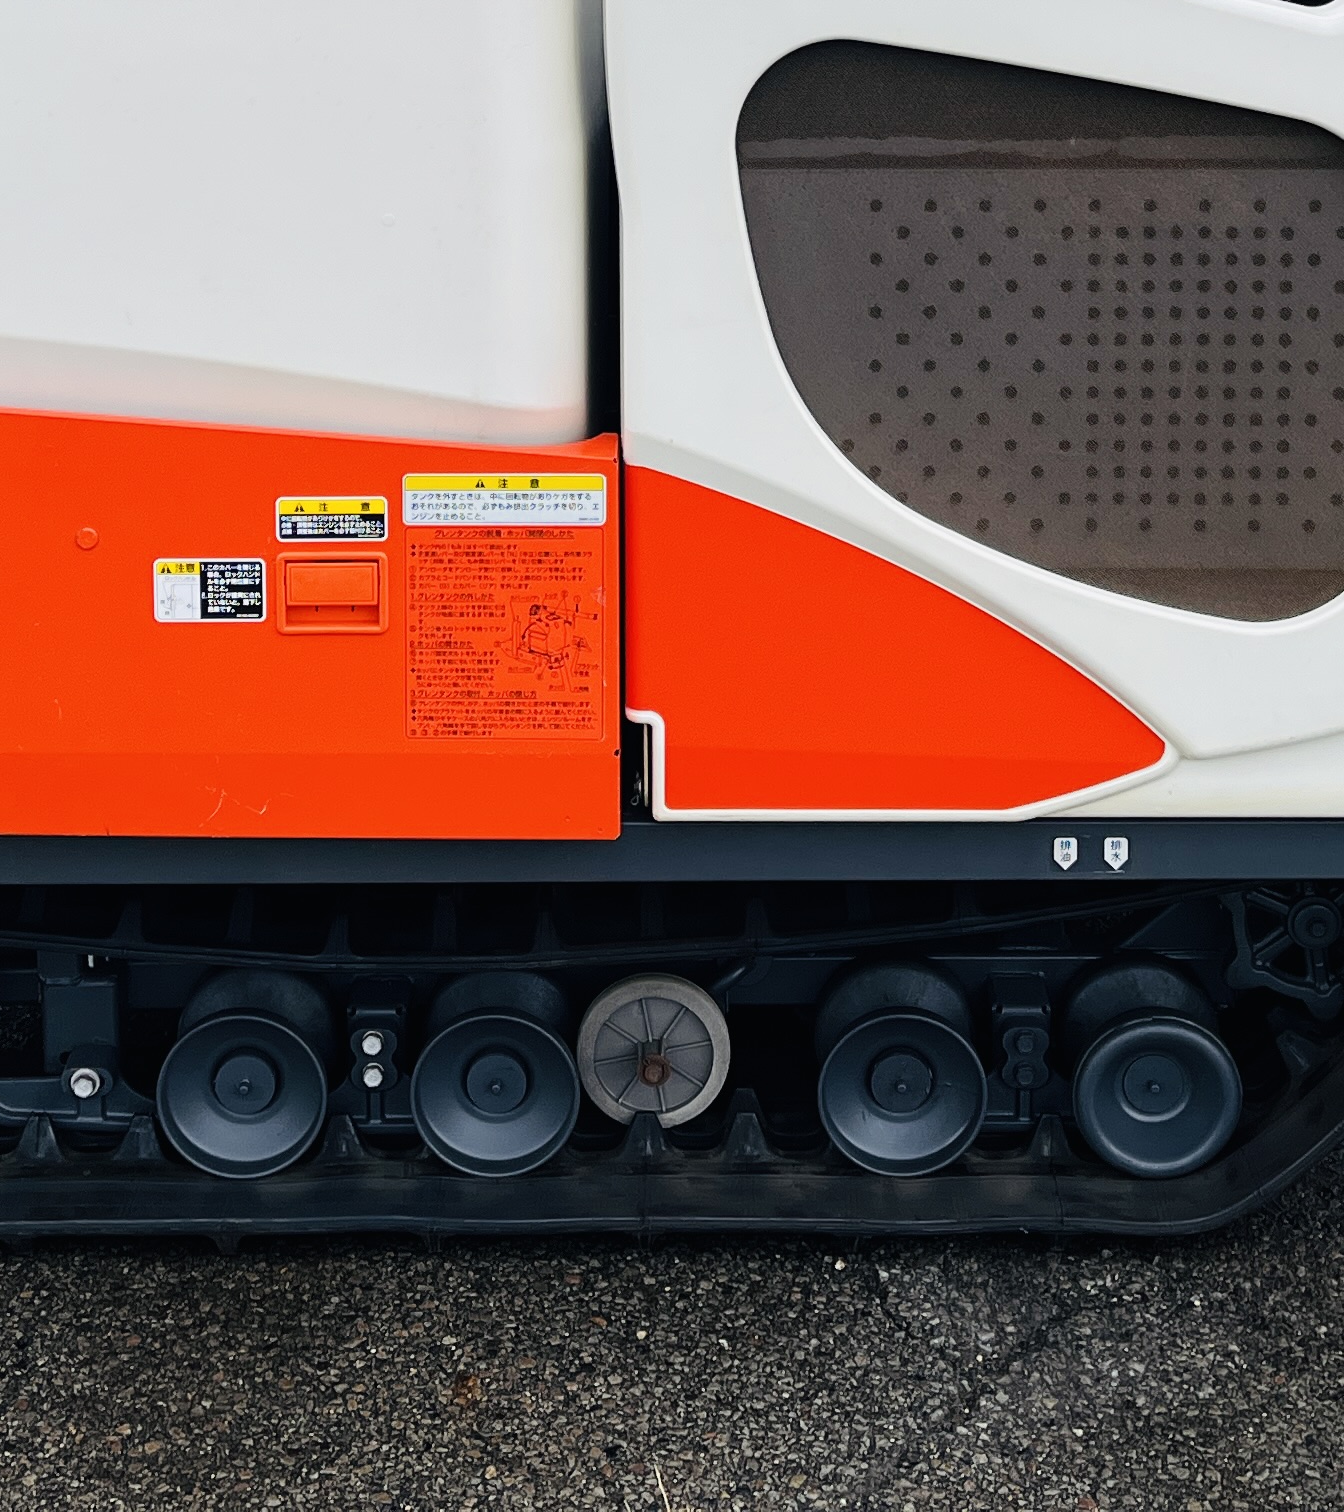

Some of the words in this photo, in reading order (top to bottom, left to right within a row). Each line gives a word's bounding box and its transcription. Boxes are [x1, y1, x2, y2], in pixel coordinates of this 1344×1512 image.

[498, 478, 540, 489] 注意
[319, 503, 370, 512] 注意
[175, 564, 195, 573] 注意
[1060, 840, 1071, 862] 排油
[1110, 840, 1121, 862] 排水
